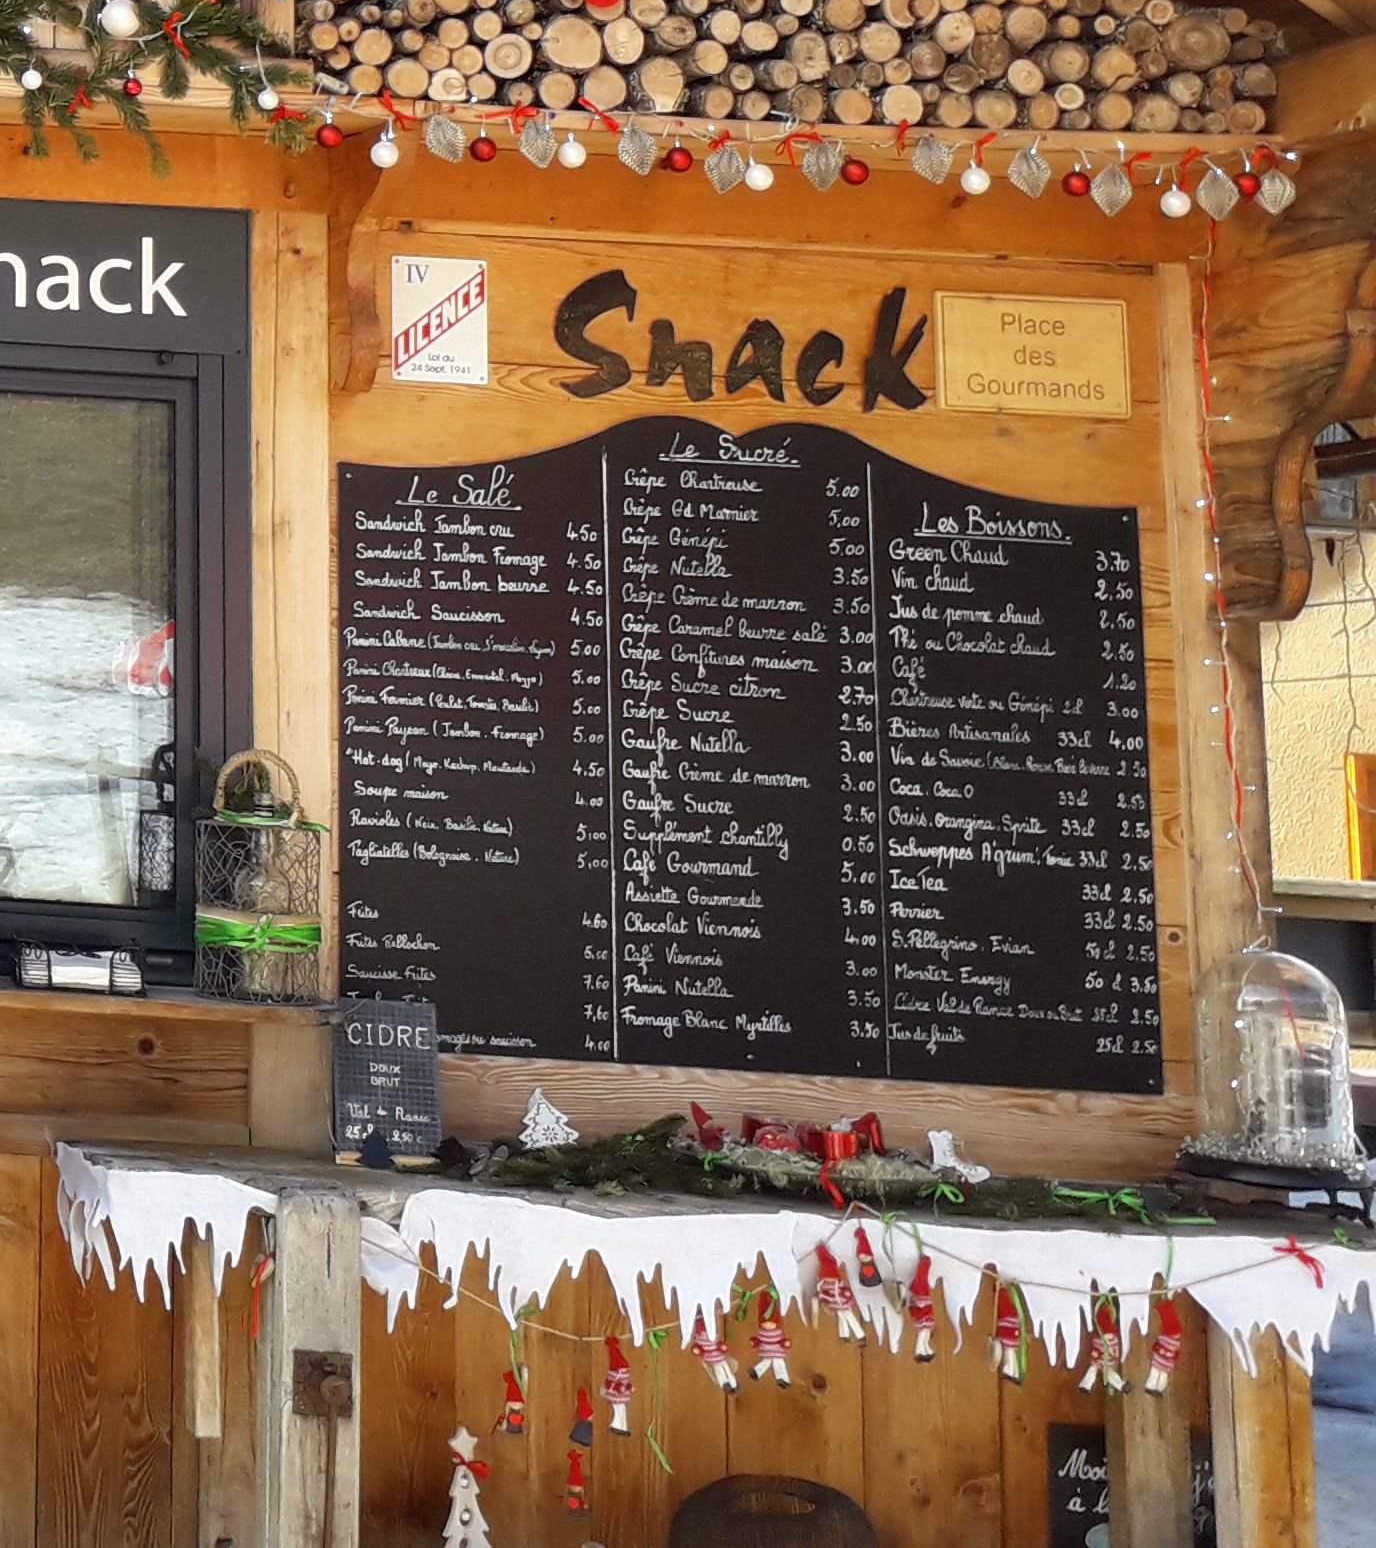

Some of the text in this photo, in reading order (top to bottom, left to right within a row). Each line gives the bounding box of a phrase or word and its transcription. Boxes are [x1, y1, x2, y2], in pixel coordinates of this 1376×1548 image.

[405, 263, 430, 284] IV
[397, 273, 483, 367] LICENCE
[1000, 312, 1065, 336] Place
[553, 268, 933, 414] Snack
[410, 363, 423, 372] 24
[441, 353, 455, 362] du
[1013, 345, 1056, 366] des
[966, 373, 1105, 401] Gourmands
[624, 468, 667, 494] Crêpe
[355, 509, 427, 533] Sandwich
[623, 498, 662, 524] Crêpe
[355, 538, 426, 562] Sandwich
[622, 527, 660, 555] Crêpe
[354, 568, 423, 590] Sandwich
[623, 557, 660, 582] Crêpe
[353, 599, 421, 620] Sandwich
[622, 583, 666, 613] Crêpe
[622, 613, 661, 643] Crêpe
[619, 638, 663, 671] Crêpe
[622, 669, 663, 702] Crêpe
[347, 1023, 431, 1050] CIDRE
